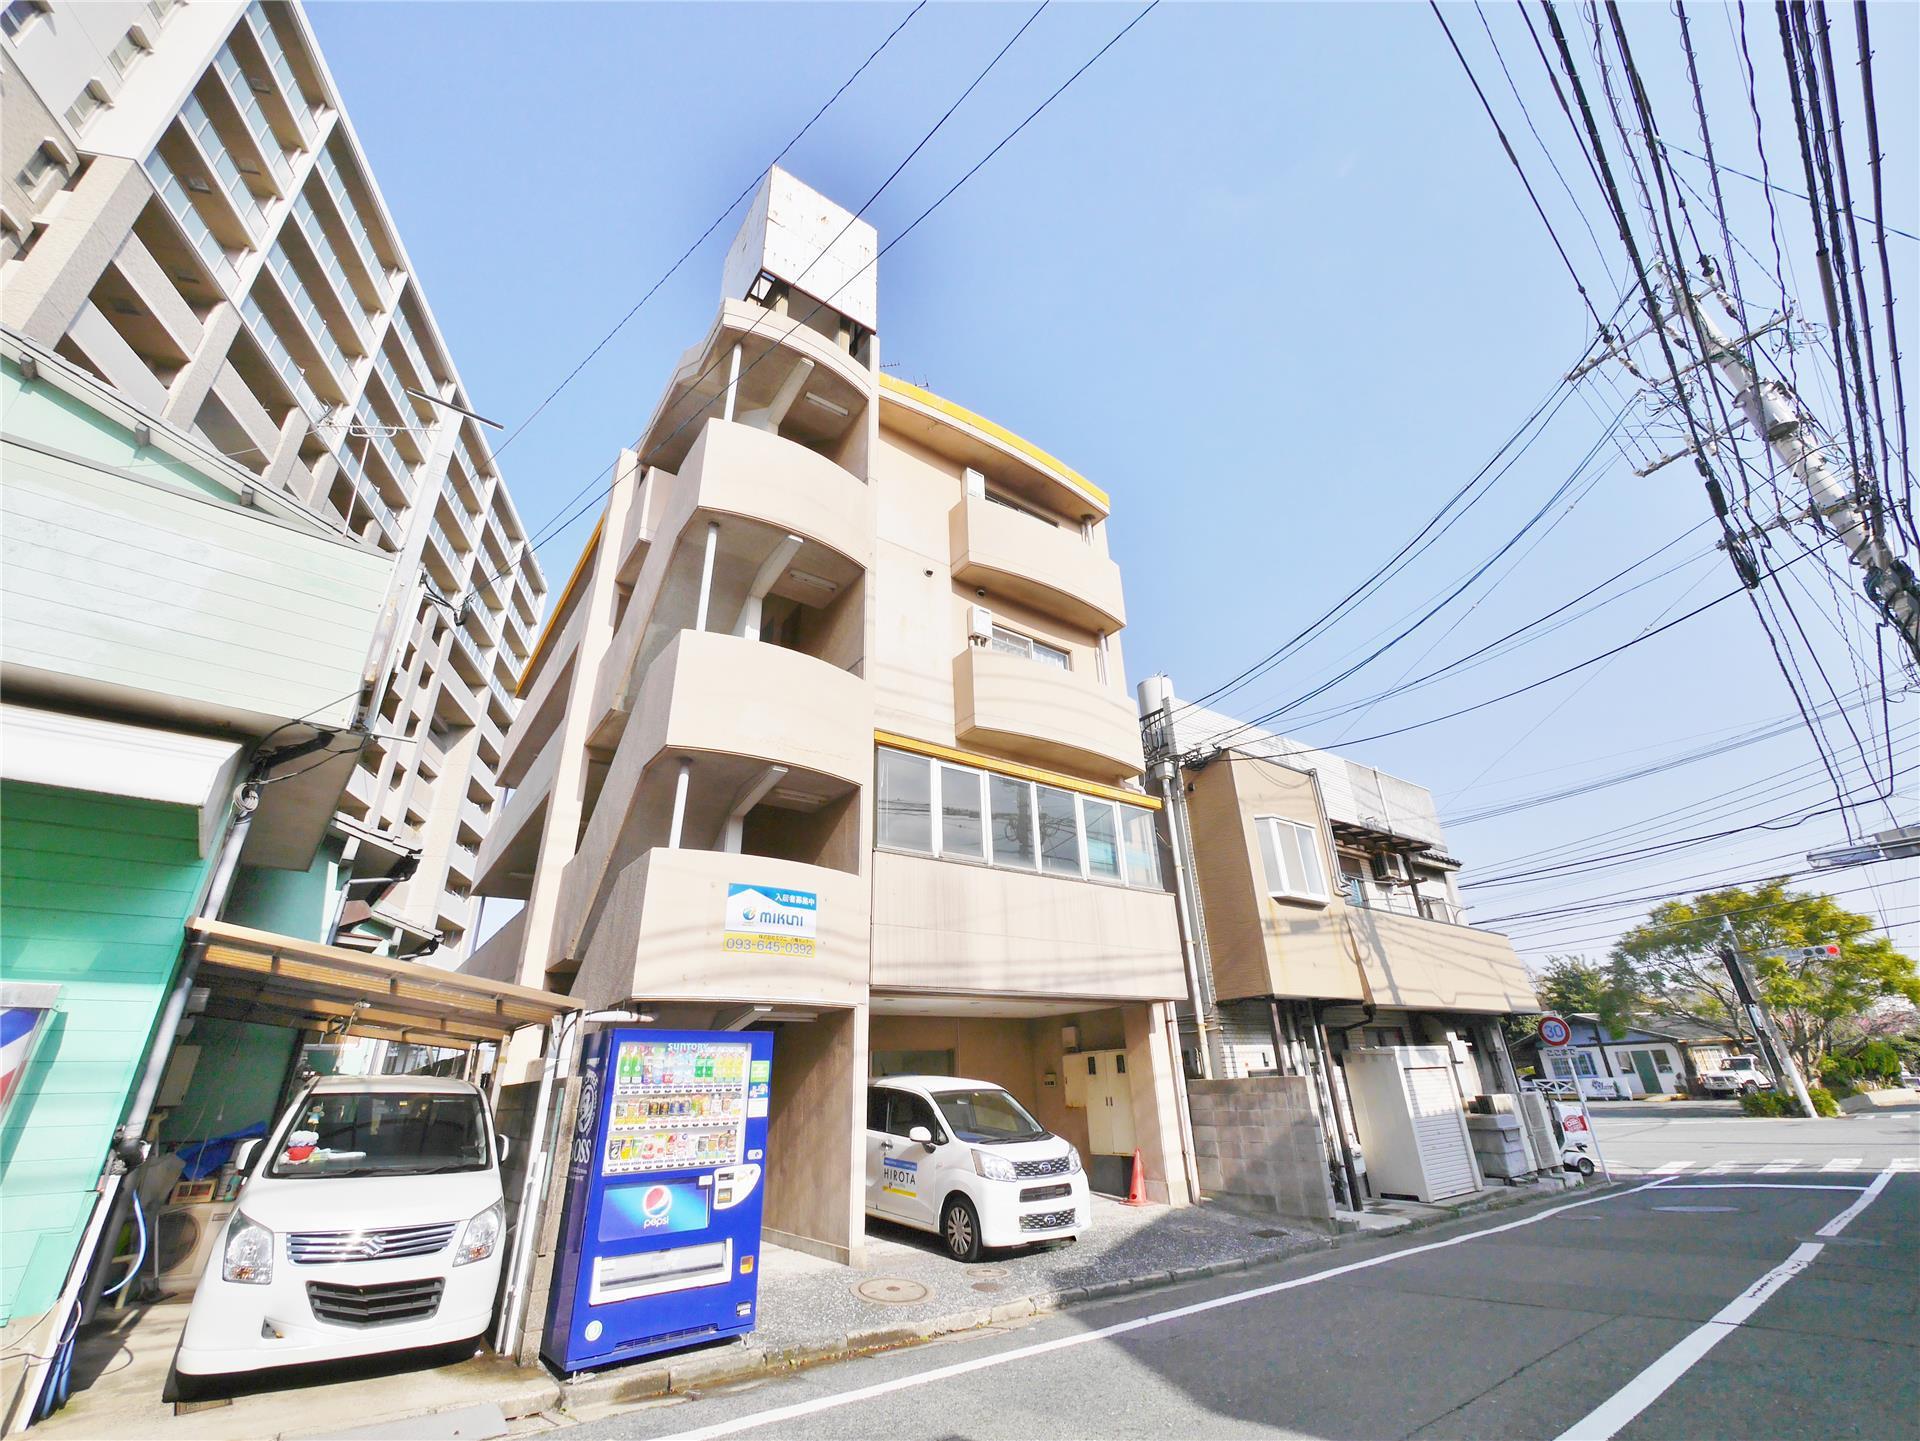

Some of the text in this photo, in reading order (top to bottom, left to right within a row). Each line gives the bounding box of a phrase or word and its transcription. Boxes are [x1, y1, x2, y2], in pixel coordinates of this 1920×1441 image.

[726, 938, 812, 955] 093-645-0392
[1545, 1024, 1564, 1038] 30
[571, 1138, 592, 1164] OSS
[884, 1168, 915, 1184] HIROTA
[644, 1216, 669, 1229] pepsi
